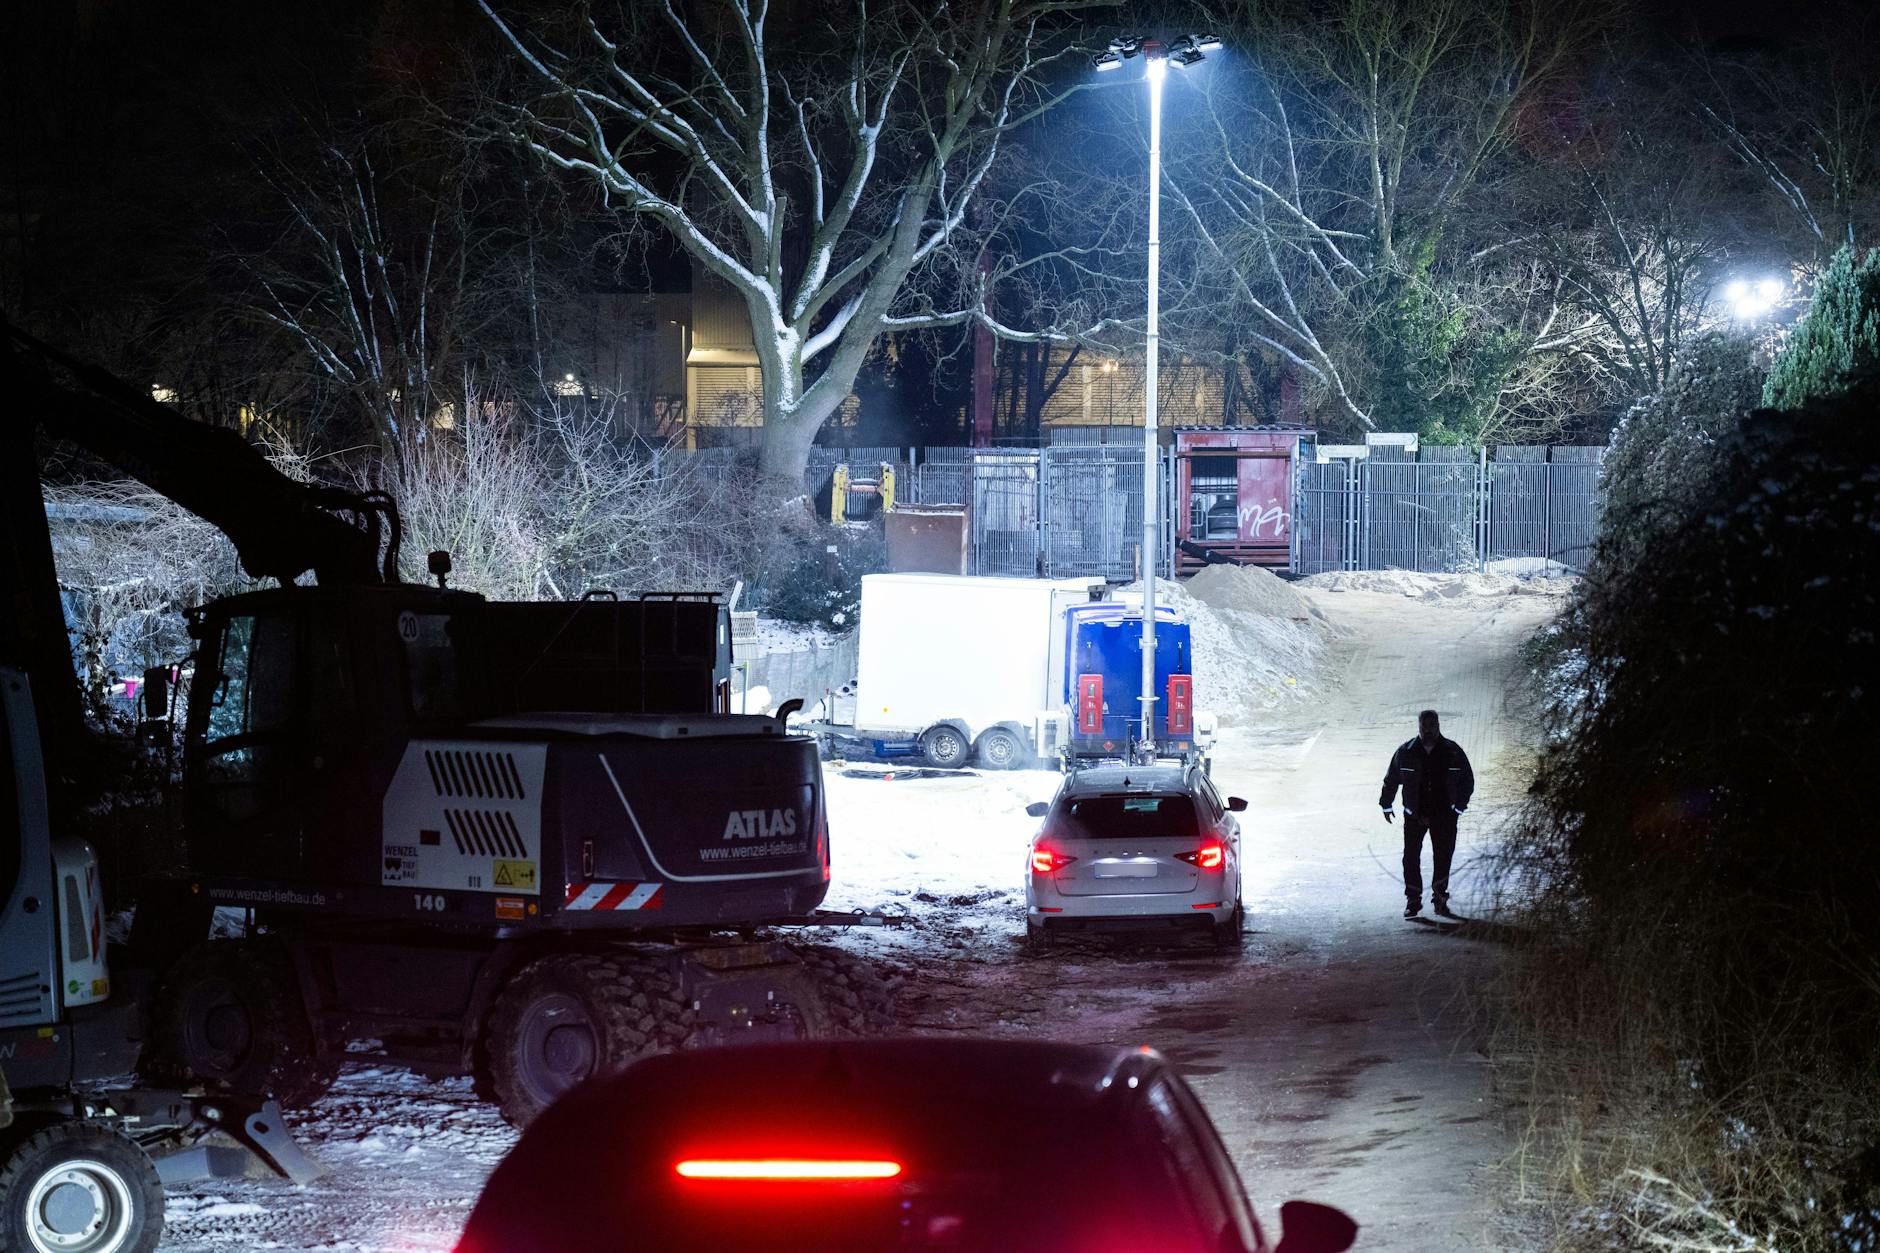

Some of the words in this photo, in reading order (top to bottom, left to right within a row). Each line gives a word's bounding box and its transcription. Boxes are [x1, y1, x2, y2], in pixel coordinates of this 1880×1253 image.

[401, 616, 417, 638] 20
[723, 808, 796, 840] ATLAS
[384, 845, 418, 857] WENZEL
[402, 860, 415, 869] TIEF
[402, 870, 415, 880] BAU
[209, 888, 326, 905] www.wenzel-tiefbau.de
[414, 893, 446, 912] 140
